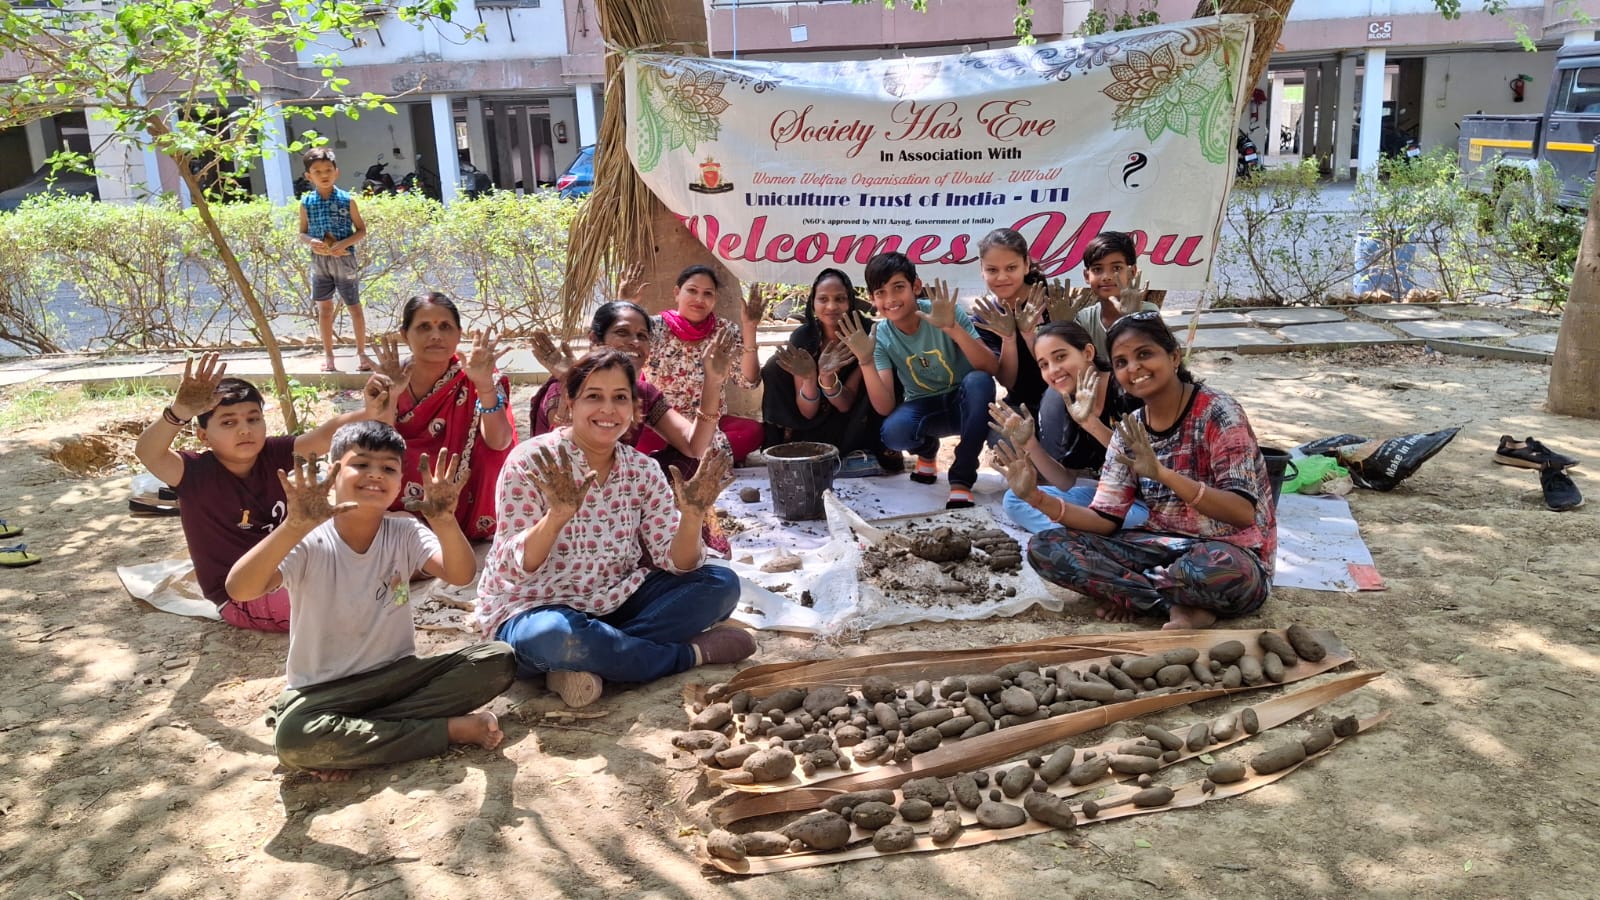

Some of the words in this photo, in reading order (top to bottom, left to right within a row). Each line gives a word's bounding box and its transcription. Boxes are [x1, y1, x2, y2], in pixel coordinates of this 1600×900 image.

[1369, 22, 1391, 33] C-5
[770, 105, 876, 158] Society
[884, 100, 963, 141] Has
[976, 99, 1056, 141] Eve
[880, 150, 894, 162] In
[898, 148, 983, 162] Association
[987, 147, 1022, 160] With
[752, 172, 796, 185] Women
[800, 172, 847, 188] Welfare
[851, 171, 930, 188] Organisation
[934, 172, 951, 188] of
[951, 171, 994, 185] World
[745, 192, 850, 207] Uniculture
[857, 192, 912, 207] Trust
[918, 192, 941, 207] of
[945, 191, 1006, 207] India
[1030, 187, 1069, 203] UTI
[802, 218, 825, 226] (NGO's
[827, 218, 861, 226] approved
[862, 218, 870, 226] by
[888, 218, 912, 226] Aayog,
[971, 217, 995, 225] India)
[1385, 453, 1403, 478] Make
